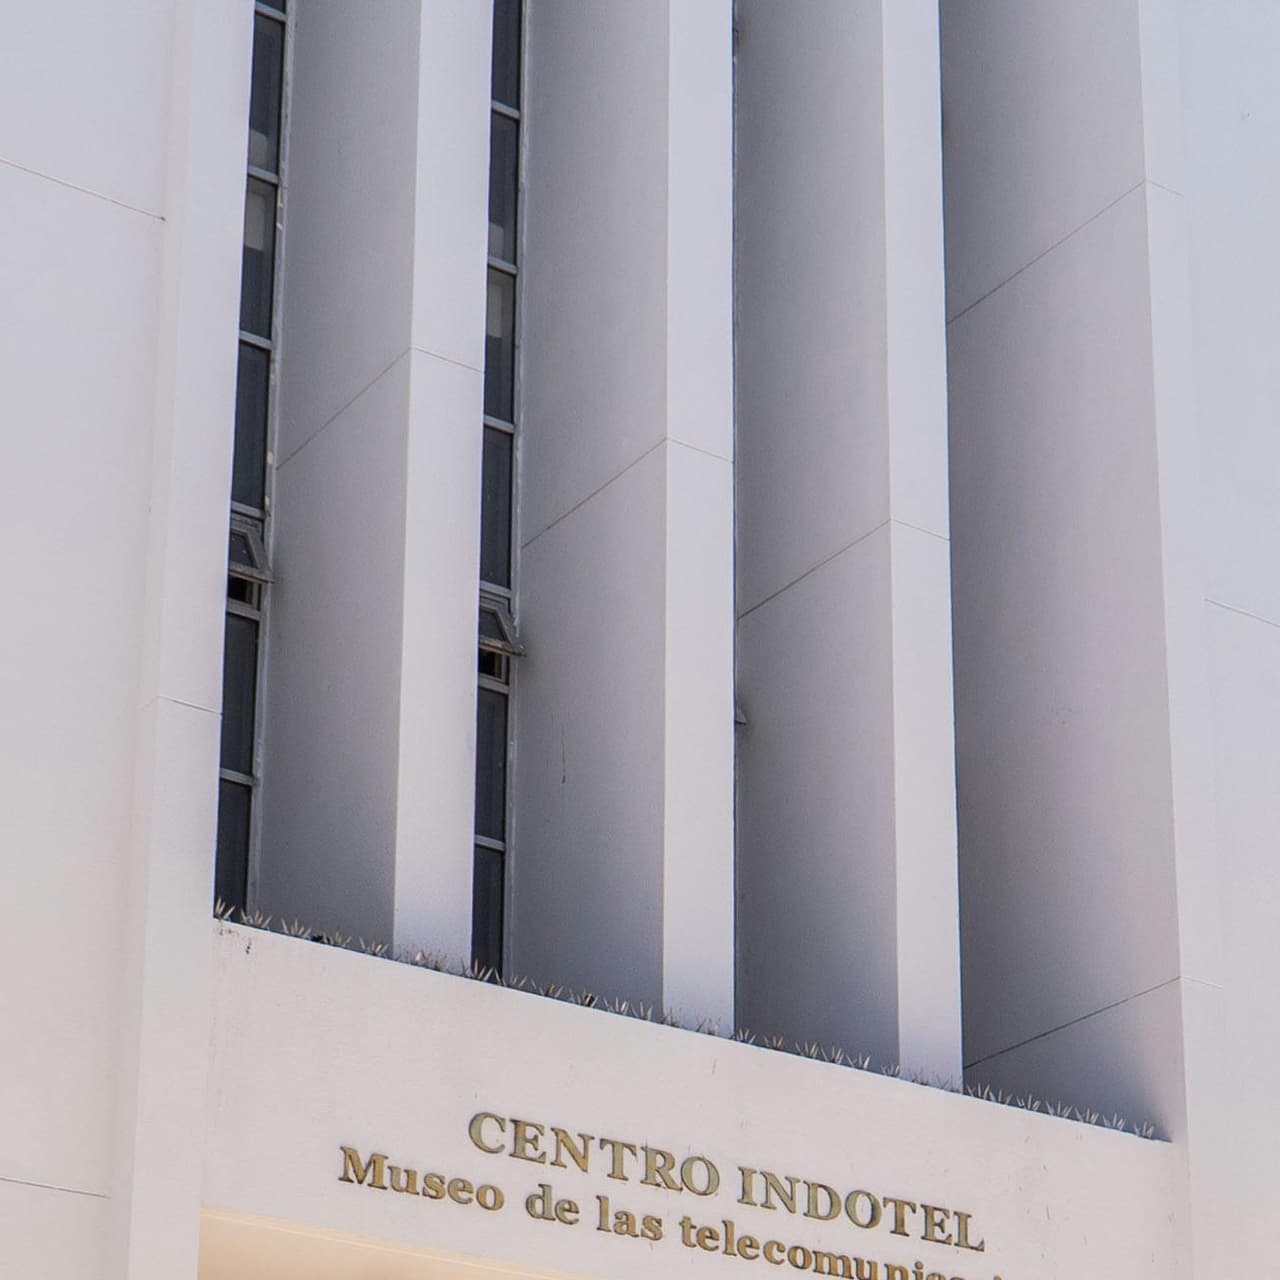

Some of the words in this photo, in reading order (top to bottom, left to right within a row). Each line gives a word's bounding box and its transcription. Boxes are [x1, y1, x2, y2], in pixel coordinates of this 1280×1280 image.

[338, 1146, 505, 1211] Museo
[525, 1183, 580, 1226] de
[596, 1195, 663, 1241] las
[468, 1111, 720, 1198] CENTRO
[736, 1166, 986, 1253] INDOTEL
